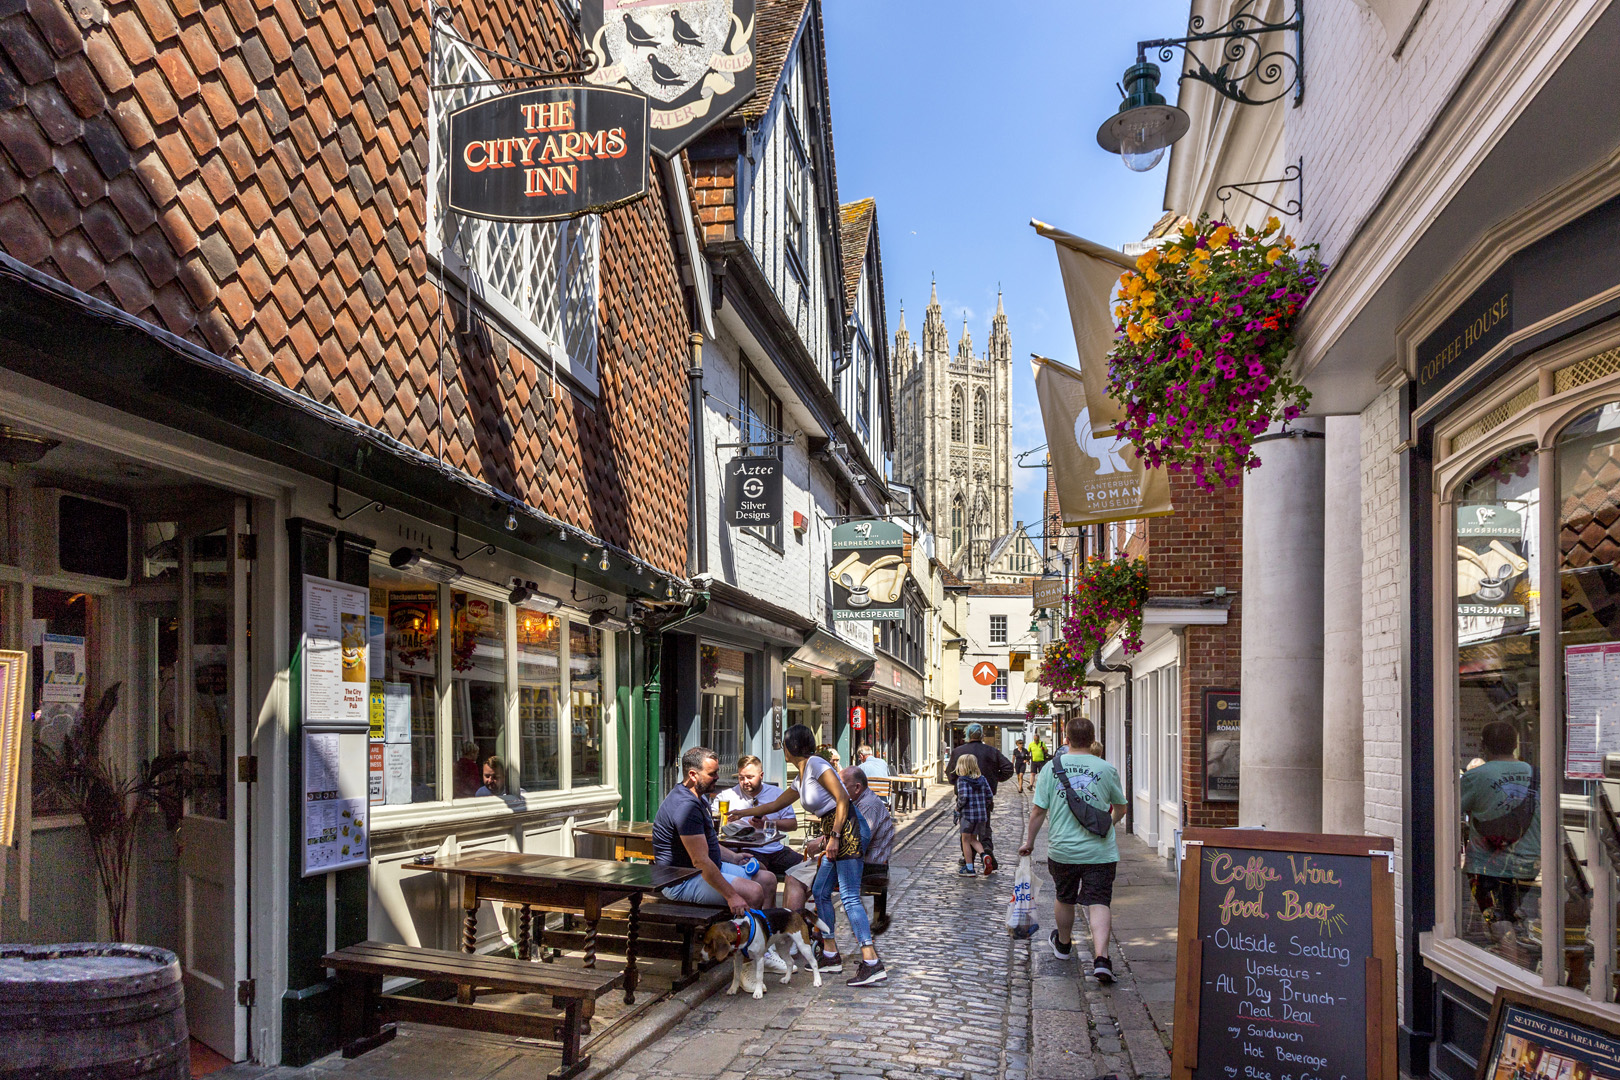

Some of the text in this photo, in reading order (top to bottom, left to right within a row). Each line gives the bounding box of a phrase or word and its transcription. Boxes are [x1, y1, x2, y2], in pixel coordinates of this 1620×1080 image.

[593, 67, 623, 82] AVE
[521, 100, 576, 132] THE
[463, 127, 628, 172] CITY ARMS
[523, 165, 579, 197] INN
[1421, 293, 1509, 385] COFFEE HOUSE
[732, 463, 774, 476] Aztec
[1084, 478, 1140, 491] CANTERBURY
[1086, 486, 1141, 501] ROMAN
[740, 501, 767, 510] Silver
[735, 510, 771, 521] Designs
[1035, 587, 1062, 598] ROMAN
[836, 610, 900, 618] SHAKESPEARE
[353, 688, 362, 696] City
[1053, 767, 1102, 782] CRIBBEAN
[1211, 852, 1343, 891] Coffee, Wine,
[1218, 886, 1336, 925] food, Beer
[1214, 927, 1278, 954] Outside
[1288, 935, 1351, 967] Seating
[1246, 958, 1310, 979] Upstairs
[1216, 973, 1238, 995] All
[1244, 975, 1272, 1004] Day
[1279, 979, 1335, 1006] Brunch
[1238, 1000, 1315, 1024] Meal Deal
[1227, 1024, 1304, 1042] any Sandwich
[1513, 1014, 1547, 1031] SEATING
[1547, 1026, 1569, 1039] AREA
[1593, 1040, 1615, 1053] AREA
[1243, 1041, 1328, 1072] Hot Beverage
[1224, 1065, 1238, 1078] any
